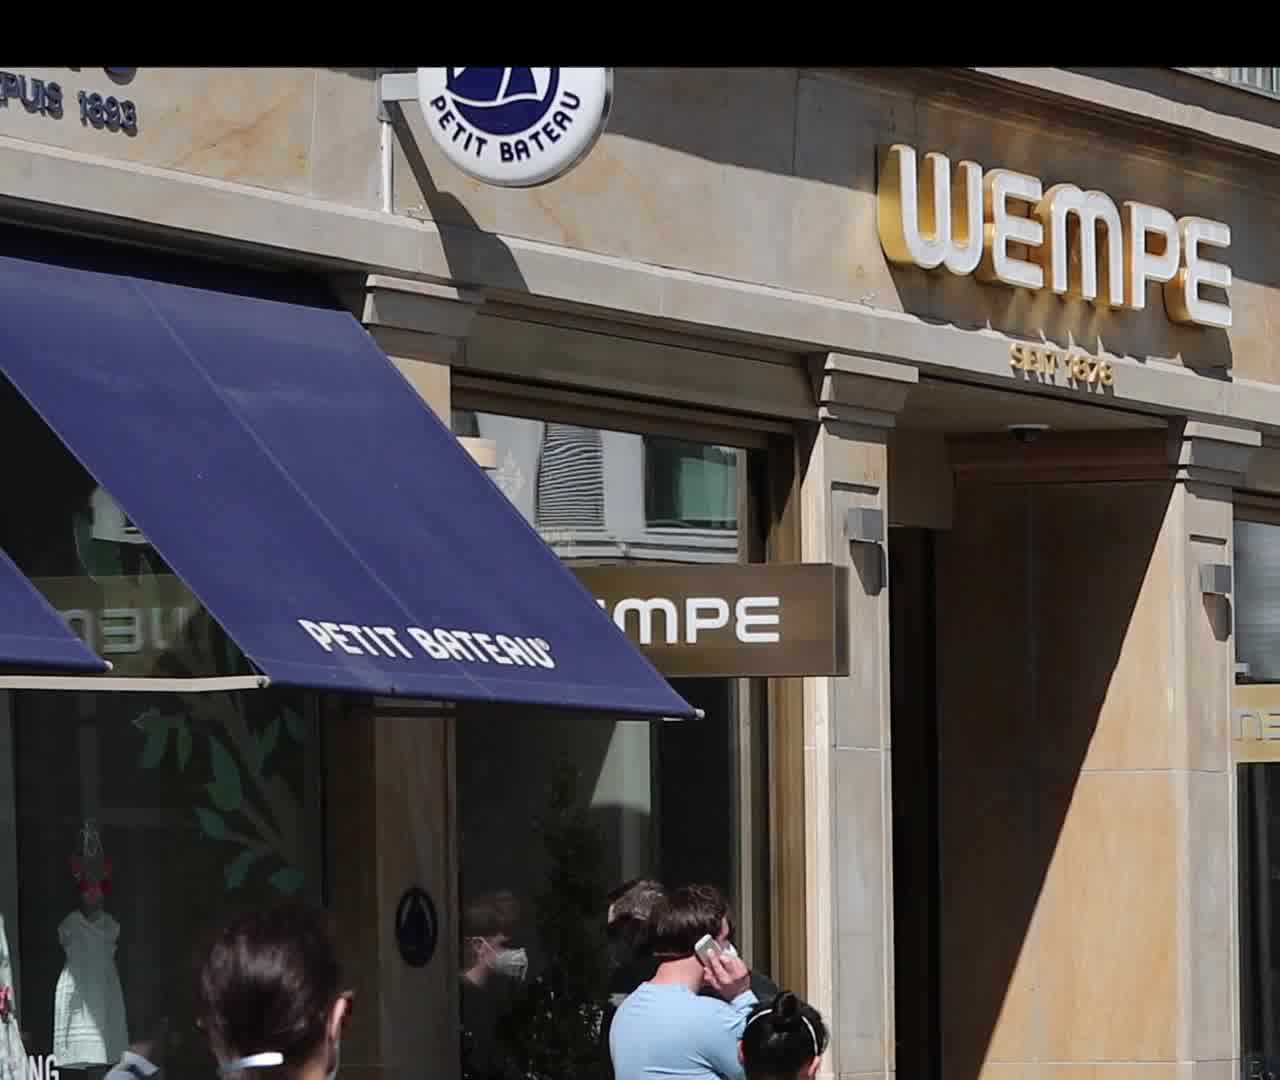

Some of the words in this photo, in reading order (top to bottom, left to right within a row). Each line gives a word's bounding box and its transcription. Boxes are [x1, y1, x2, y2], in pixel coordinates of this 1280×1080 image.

[78, 90, 138, 137] 1893
[430, 95, 488, 158] PETIT
[500, 91, 580, 163] BATEAU
[879, 144, 1233, 328] WEMPE
[298, 618, 413, 659] PETIT
[596, 596, 780, 644] MPE
